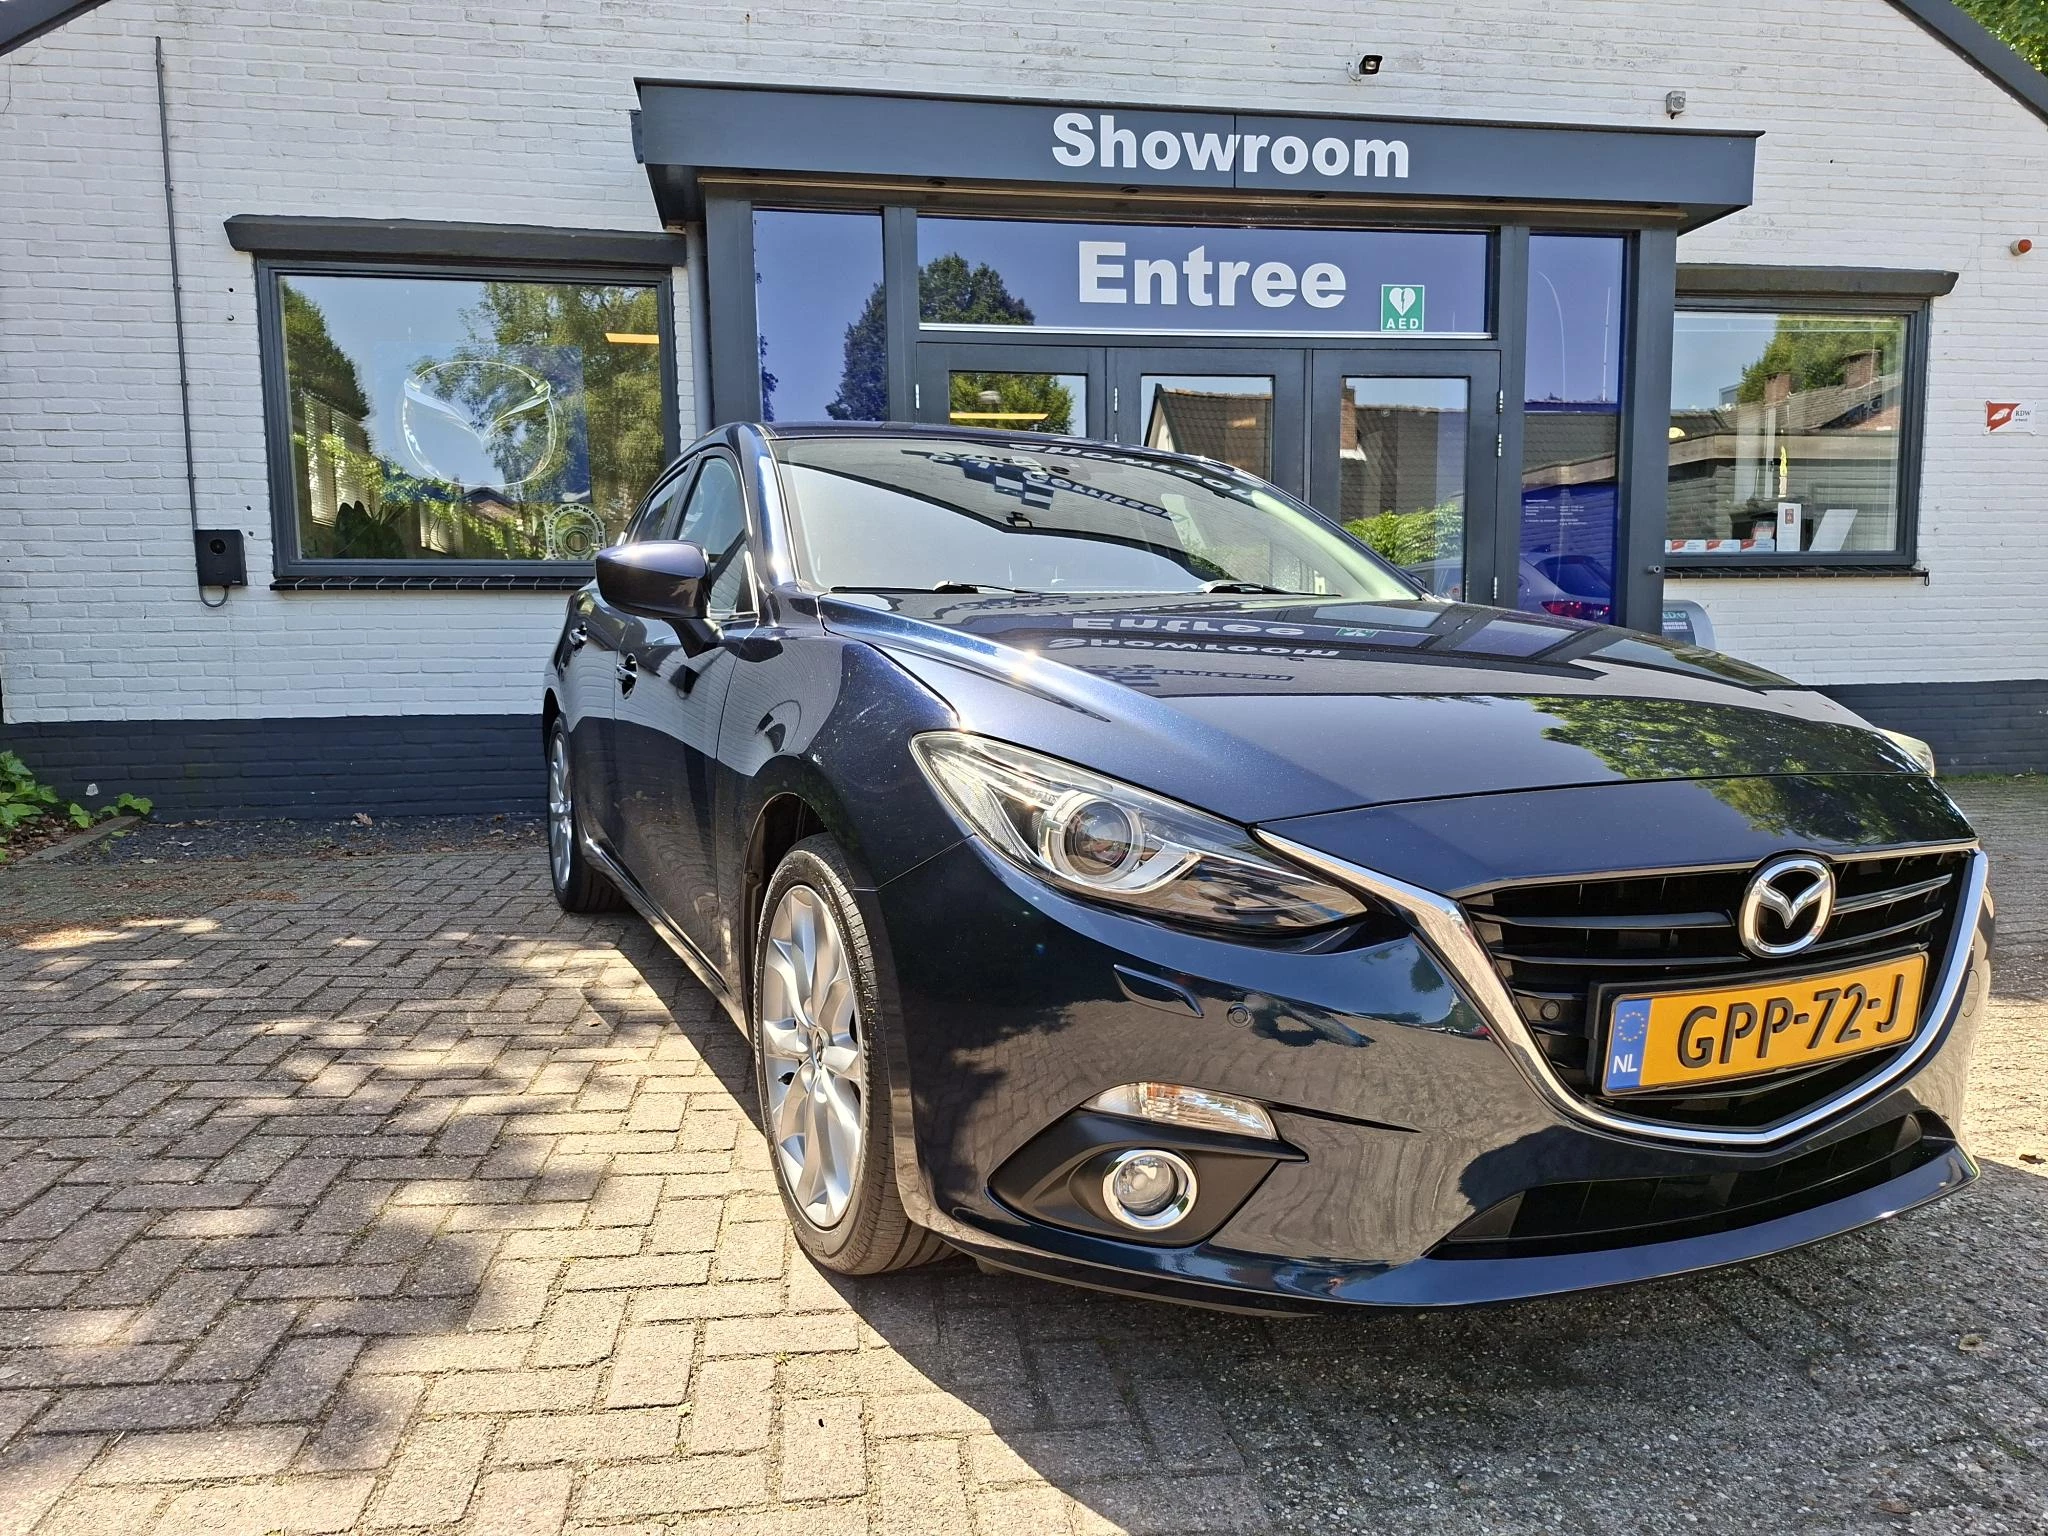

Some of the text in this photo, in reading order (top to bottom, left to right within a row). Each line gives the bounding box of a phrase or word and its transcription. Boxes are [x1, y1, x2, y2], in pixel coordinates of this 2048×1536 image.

[1052, 112, 1409, 178] Showroom
[1079, 240, 1347, 309] Entree
[1386, 318, 1419, 329] AED
[1677, 973, 1905, 1069] GPP-72-J
[1613, 1050, 1638, 1075] NL
